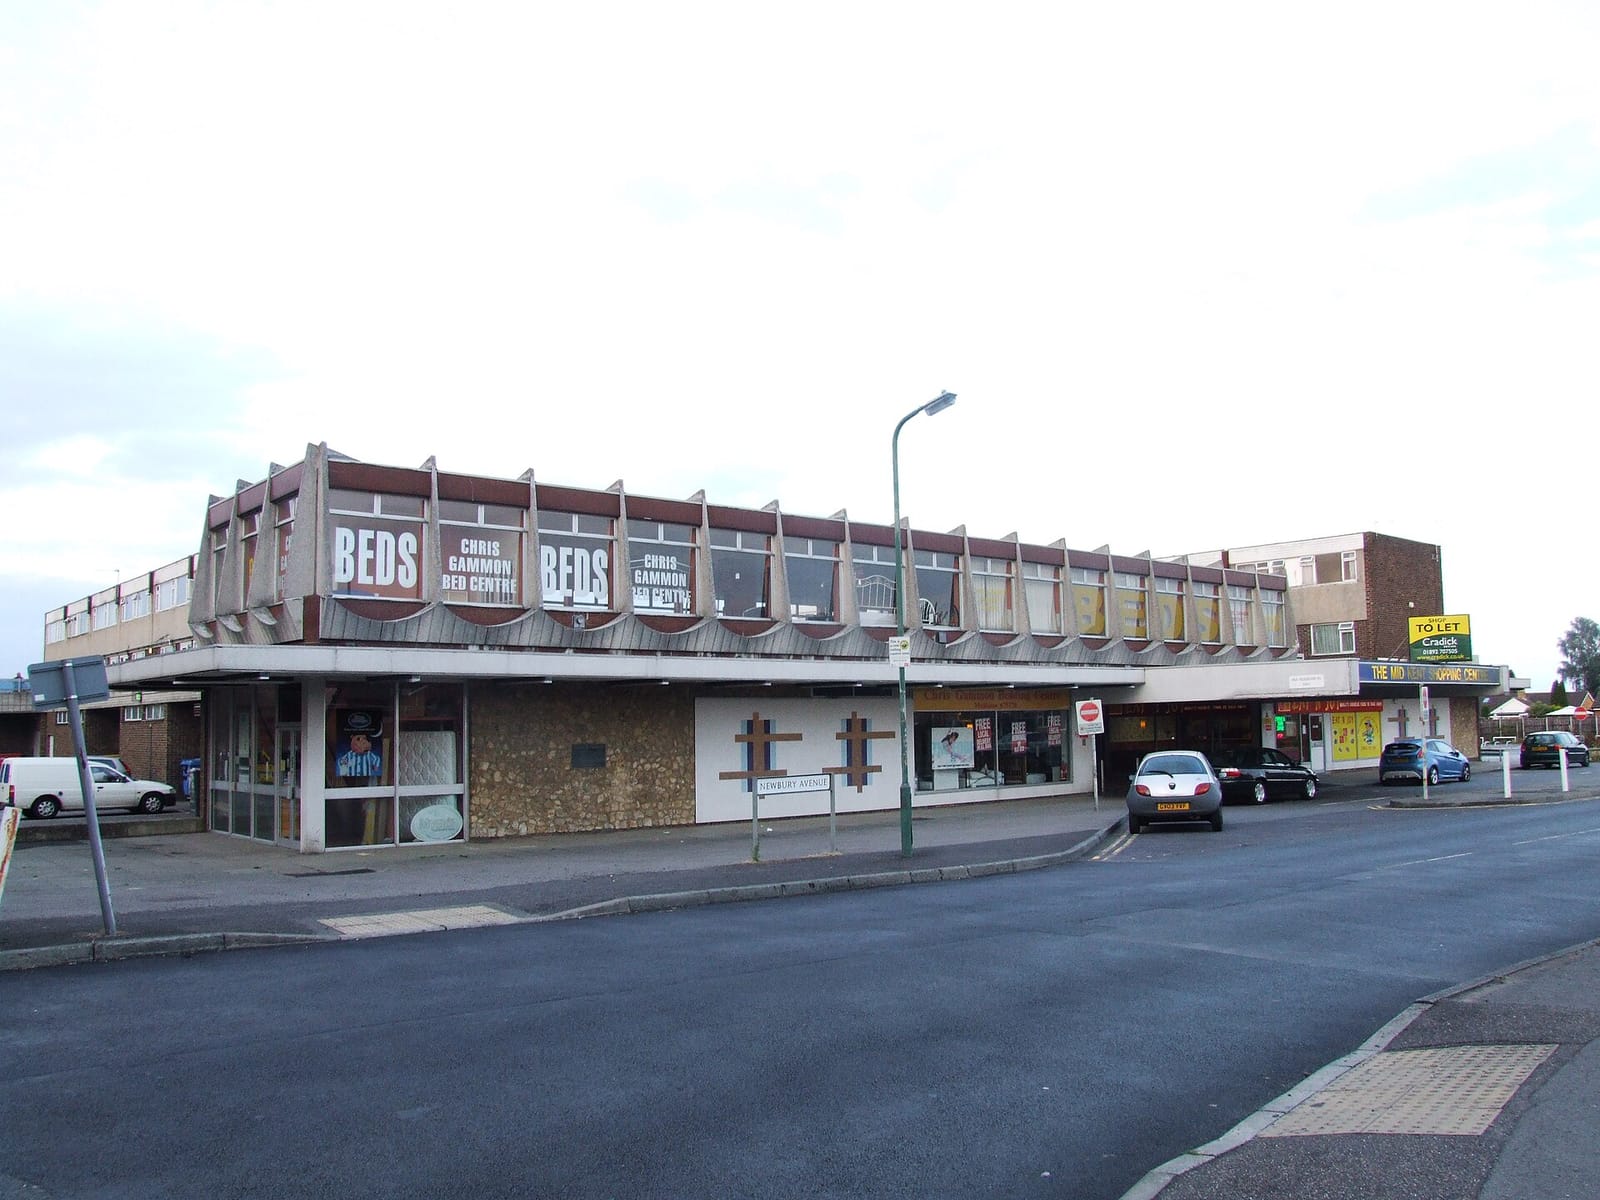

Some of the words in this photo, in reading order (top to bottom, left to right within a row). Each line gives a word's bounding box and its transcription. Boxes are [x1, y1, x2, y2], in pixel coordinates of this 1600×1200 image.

[461, 538, 500, 557] CHRIS
[335, 527, 418, 589] BEDS
[449, 556, 512, 575] GAMMON
[644, 553, 677, 570] CHRIS
[541, 544, 609, 602] BEDS
[634, 569, 687, 587] GAMMON
[442, 574, 466, 591] BED
[470, 575, 517, 594] CENTRE
[1415, 623, 1433, 633] TO
[1437, 622, 1461, 632] LET
[1422, 636, 1458, 647] Cradick
[1371, 665, 1388, 680] THE
[1390, 665, 1405, 680] MID
[1430, 666, 1462, 681] SHOPPING
[975, 718, 991, 731] FREE
[1011, 721, 1026, 735] FREE
[1047, 715, 1061, 727] FREE
[760, 780, 797, 790] NEWBURY
[799, 778, 827, 788] AVENUE
